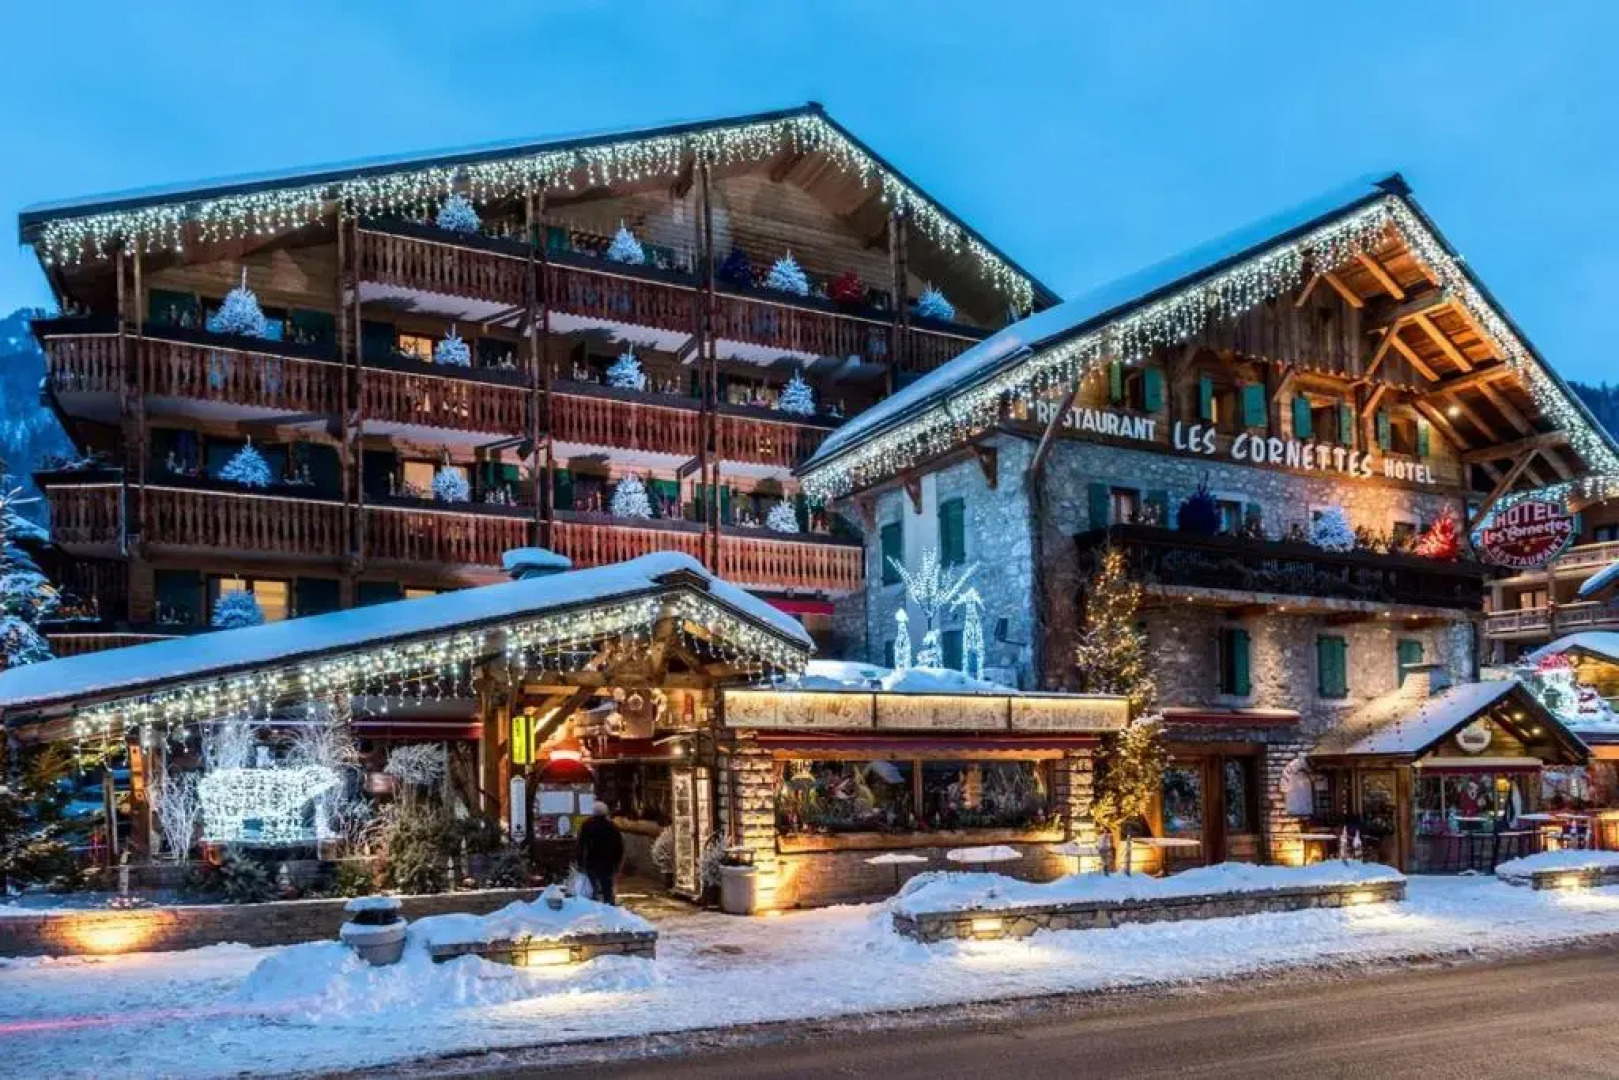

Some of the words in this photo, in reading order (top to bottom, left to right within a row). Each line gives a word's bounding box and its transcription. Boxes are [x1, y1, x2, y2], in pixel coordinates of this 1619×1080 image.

[1173, 421, 1216, 455] LES
[1231, 432, 1373, 479] CORNETTES
[1384, 457, 1437, 484] HOTEL
[1496, 502, 1560, 527] HOTEL
